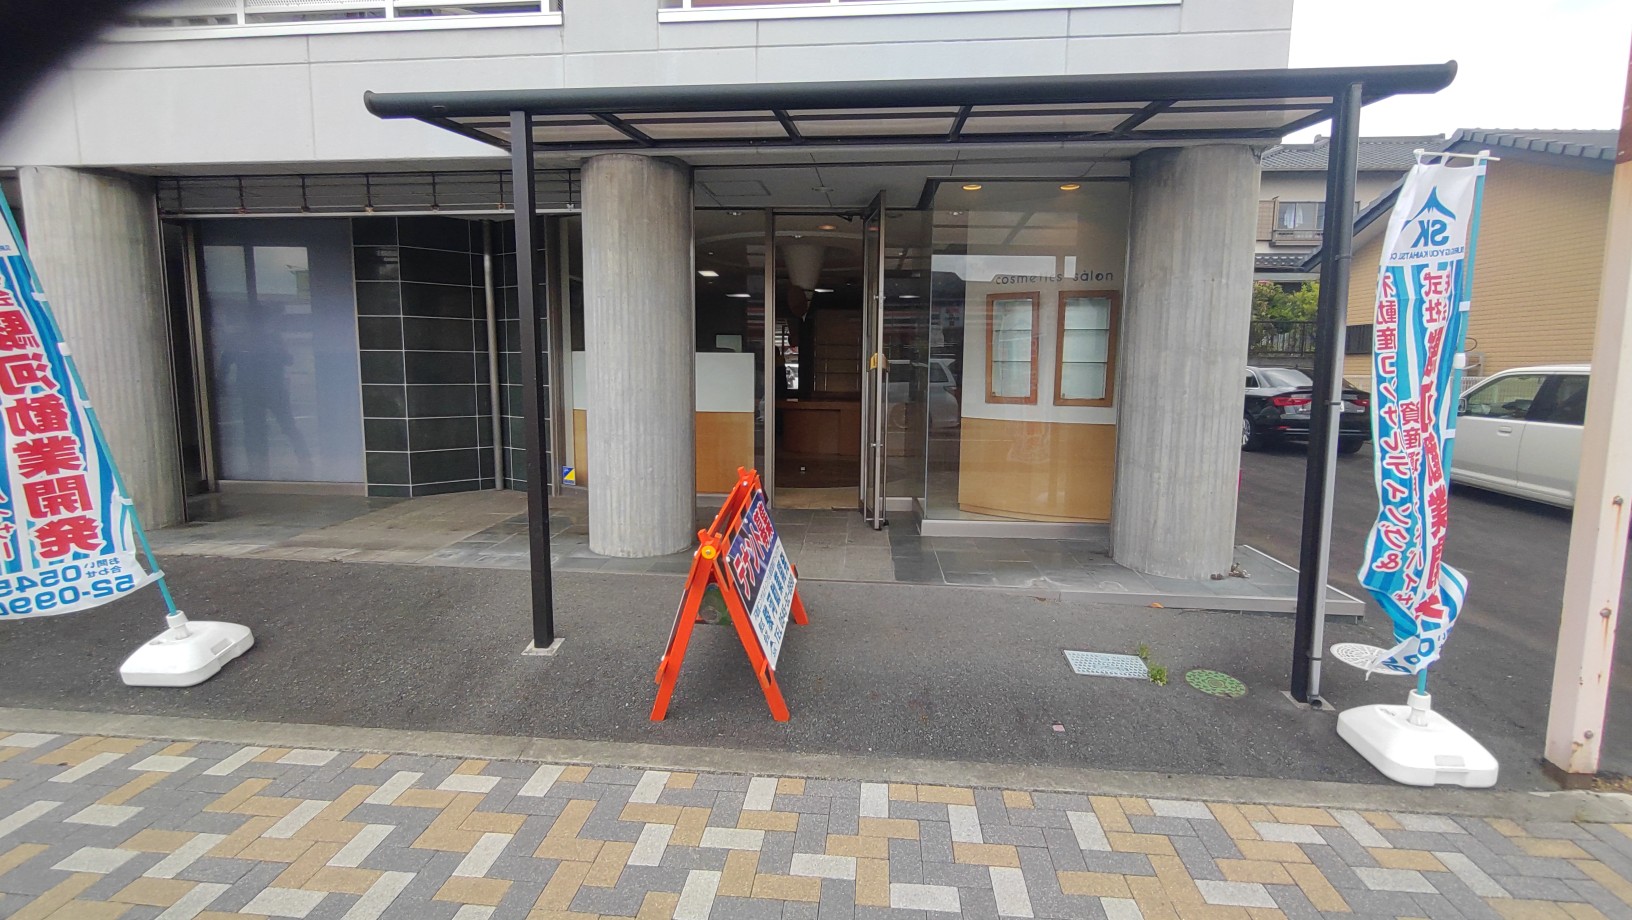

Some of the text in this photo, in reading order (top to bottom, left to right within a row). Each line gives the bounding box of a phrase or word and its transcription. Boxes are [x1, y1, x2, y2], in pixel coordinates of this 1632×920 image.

[733, 500, 774, 600] テナント募集
